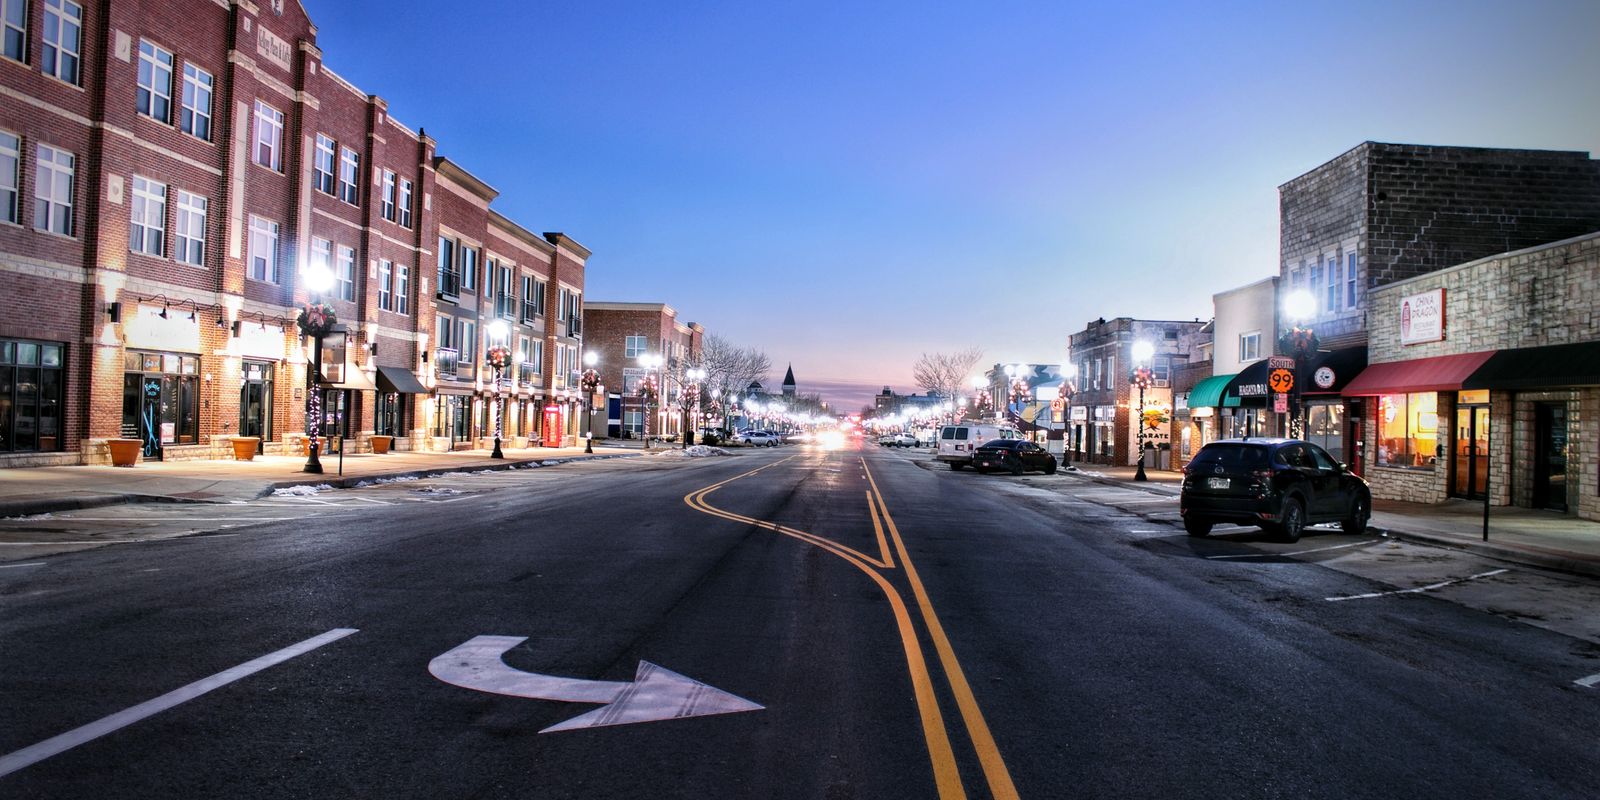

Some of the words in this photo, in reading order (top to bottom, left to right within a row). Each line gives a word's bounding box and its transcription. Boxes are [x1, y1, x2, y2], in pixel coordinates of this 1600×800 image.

[1416, 296, 1434, 308] CHINA
[1412, 306, 1438, 319] DRAGON
[1270, 358, 1294, 368] SOUTH
[1272, 373, 1291, 387] 99
